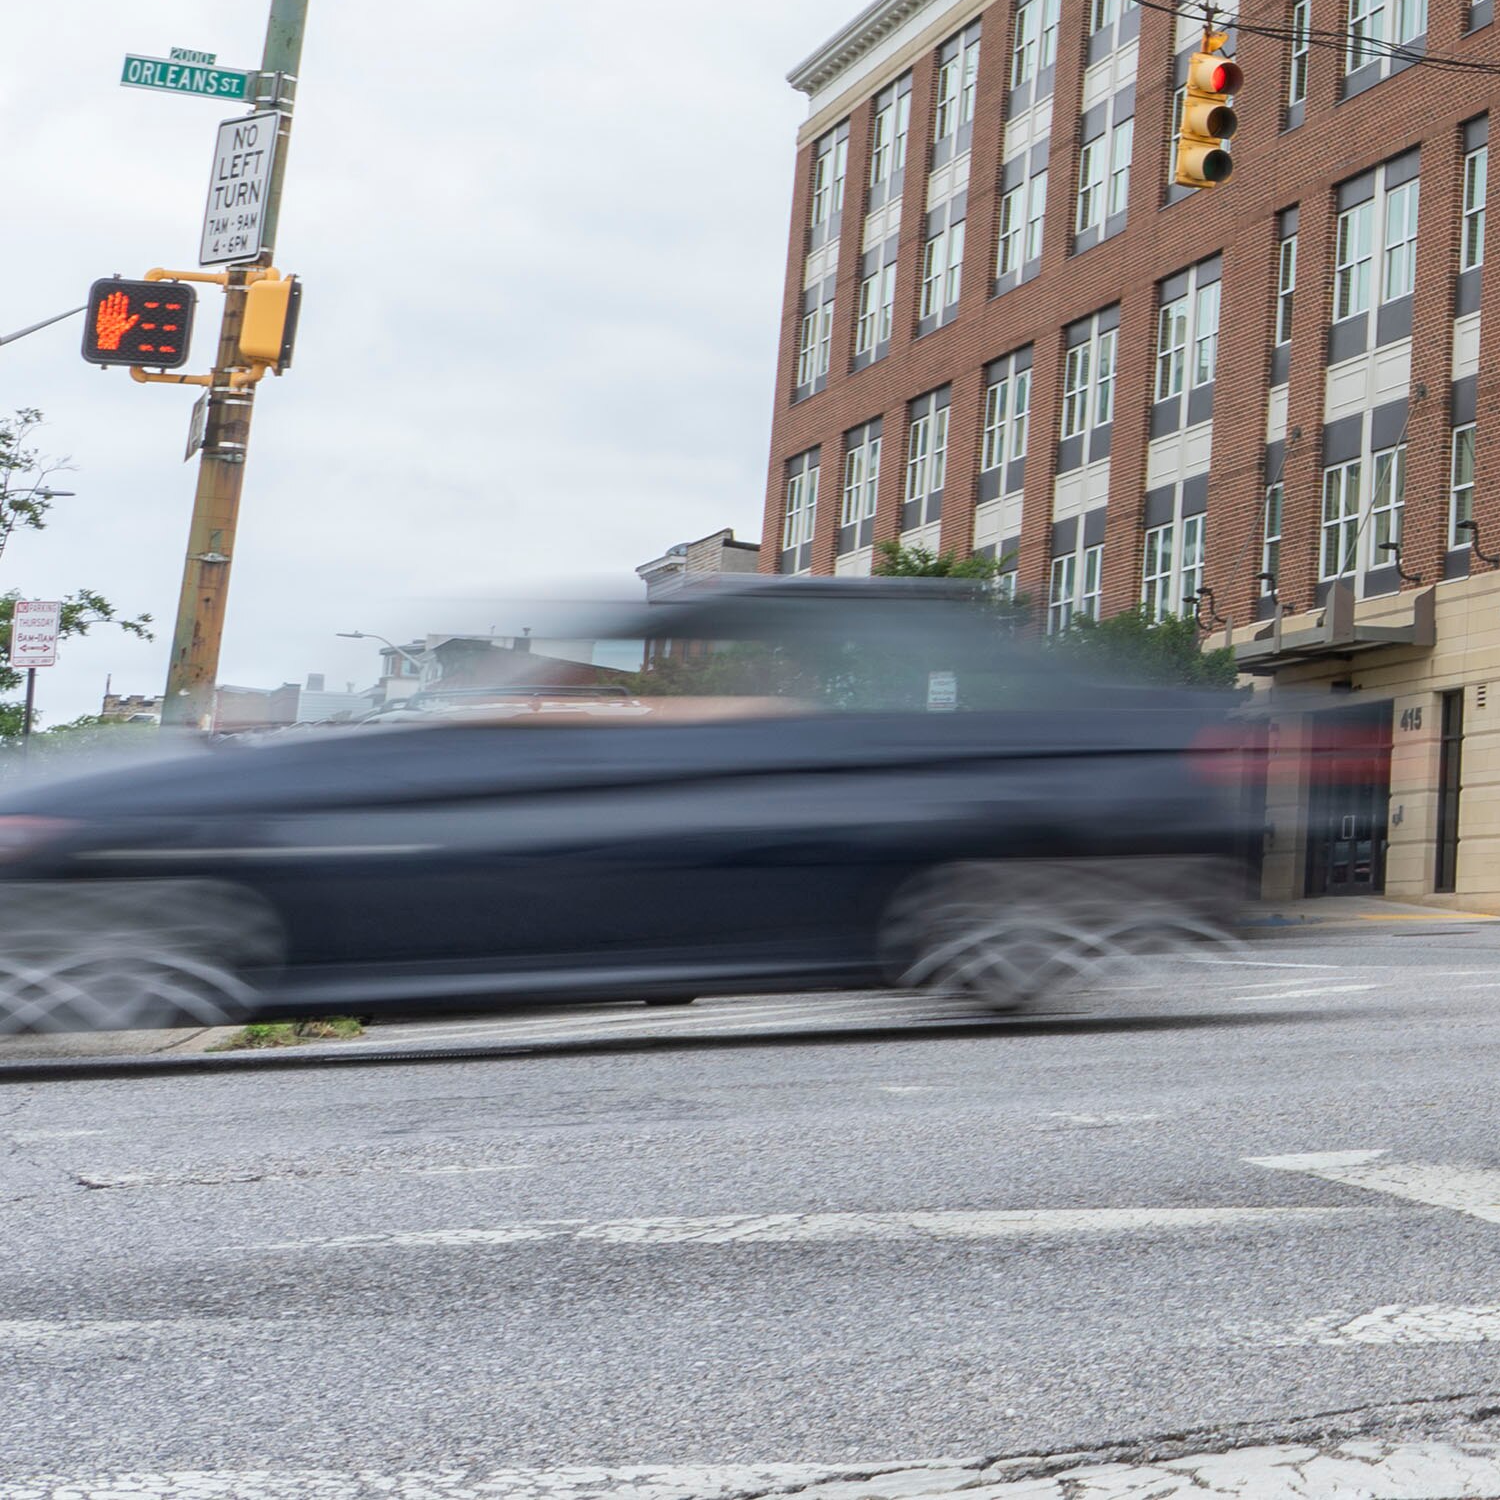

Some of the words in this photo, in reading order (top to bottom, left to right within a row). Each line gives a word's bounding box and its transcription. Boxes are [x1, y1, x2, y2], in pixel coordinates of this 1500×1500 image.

[128, 60, 219, 94] ORLEANS
[233, 124, 259, 151] NO
[218, 150, 264, 181] LEFT
[215, 179, 262, 210] TURN
[1400, 706, 1423, 732] 415
